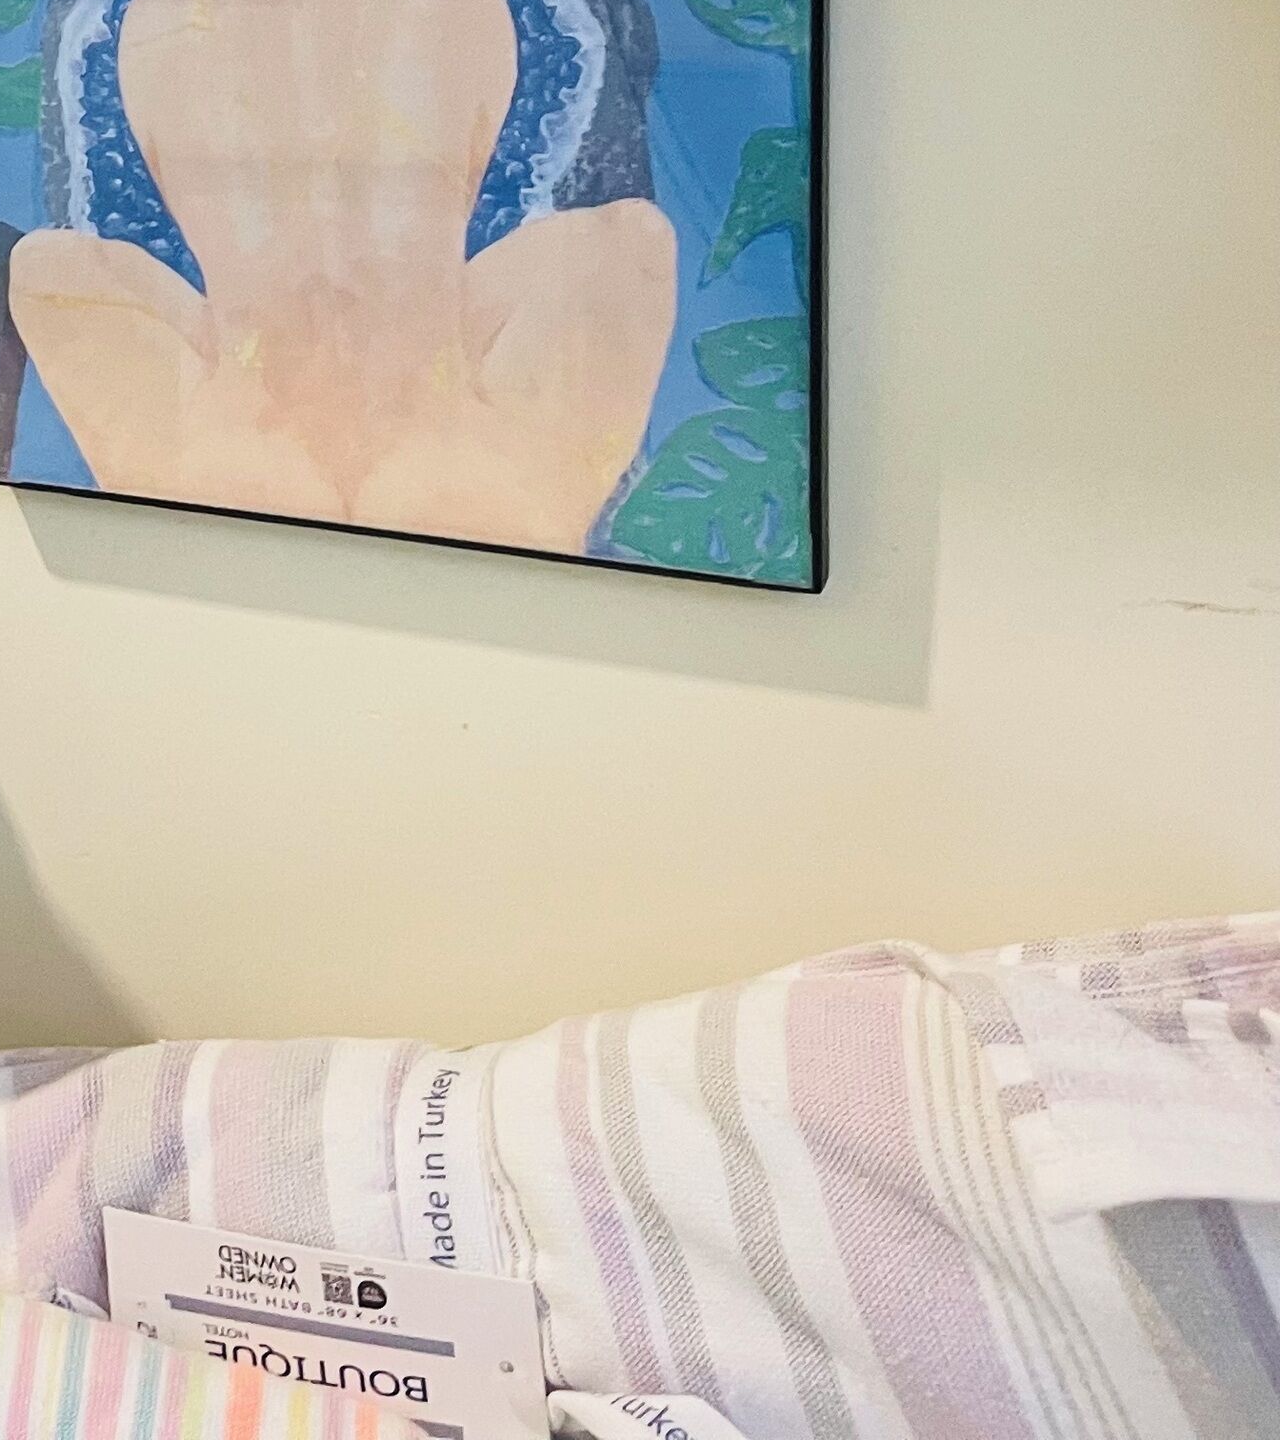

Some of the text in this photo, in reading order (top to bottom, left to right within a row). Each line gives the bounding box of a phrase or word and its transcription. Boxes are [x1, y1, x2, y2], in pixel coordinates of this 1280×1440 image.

[419, 1069, 460, 1144] Turkey
[420, 1153, 446, 1179] in
[219, 1245, 296, 1274] OWNED
[220, 1264, 301, 1293] WOMEN
[205, 1284, 257, 1304] SHEET
[266, 1296, 311, 1313] BATH
[203, 1322, 250, 1340] HOTEL
[204, 1340, 430, 1402] BOUTIQUE
